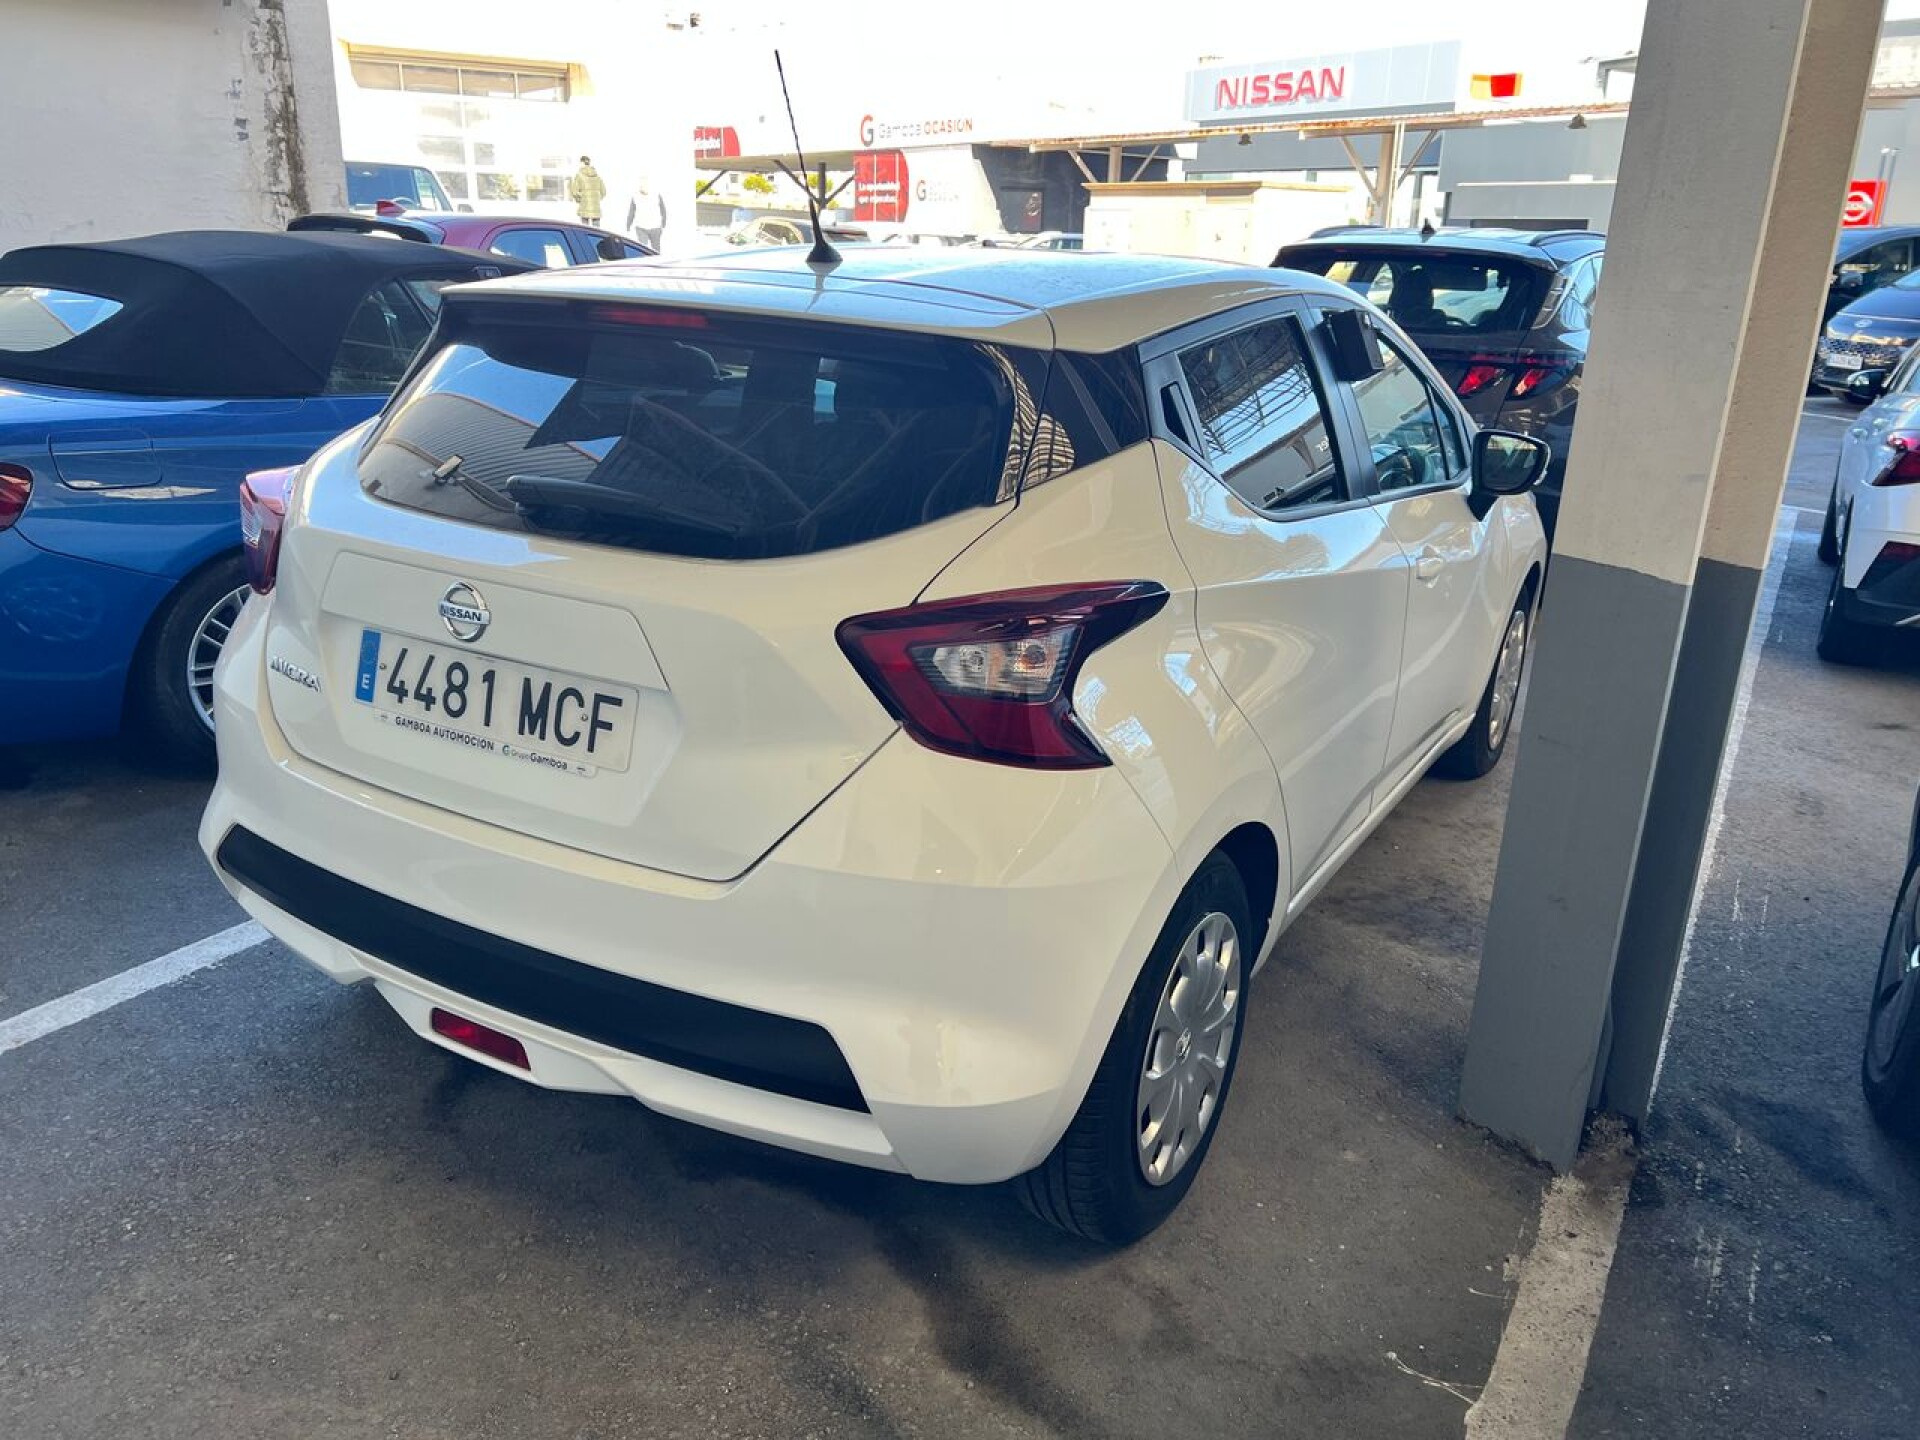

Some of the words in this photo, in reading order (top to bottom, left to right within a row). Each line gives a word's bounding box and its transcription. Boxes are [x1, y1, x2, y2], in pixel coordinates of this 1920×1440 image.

[1217, 66, 1345, 110] NISSAN
[440, 602, 482, 622] NISSAN
[361, 673, 371, 690] E
[387, 647, 496, 727] 4481
[518, 677, 623, 753] MCF
[395, 716, 431, 734] GAMBOA
[433, 727, 495, 751] AUTOMOCION
